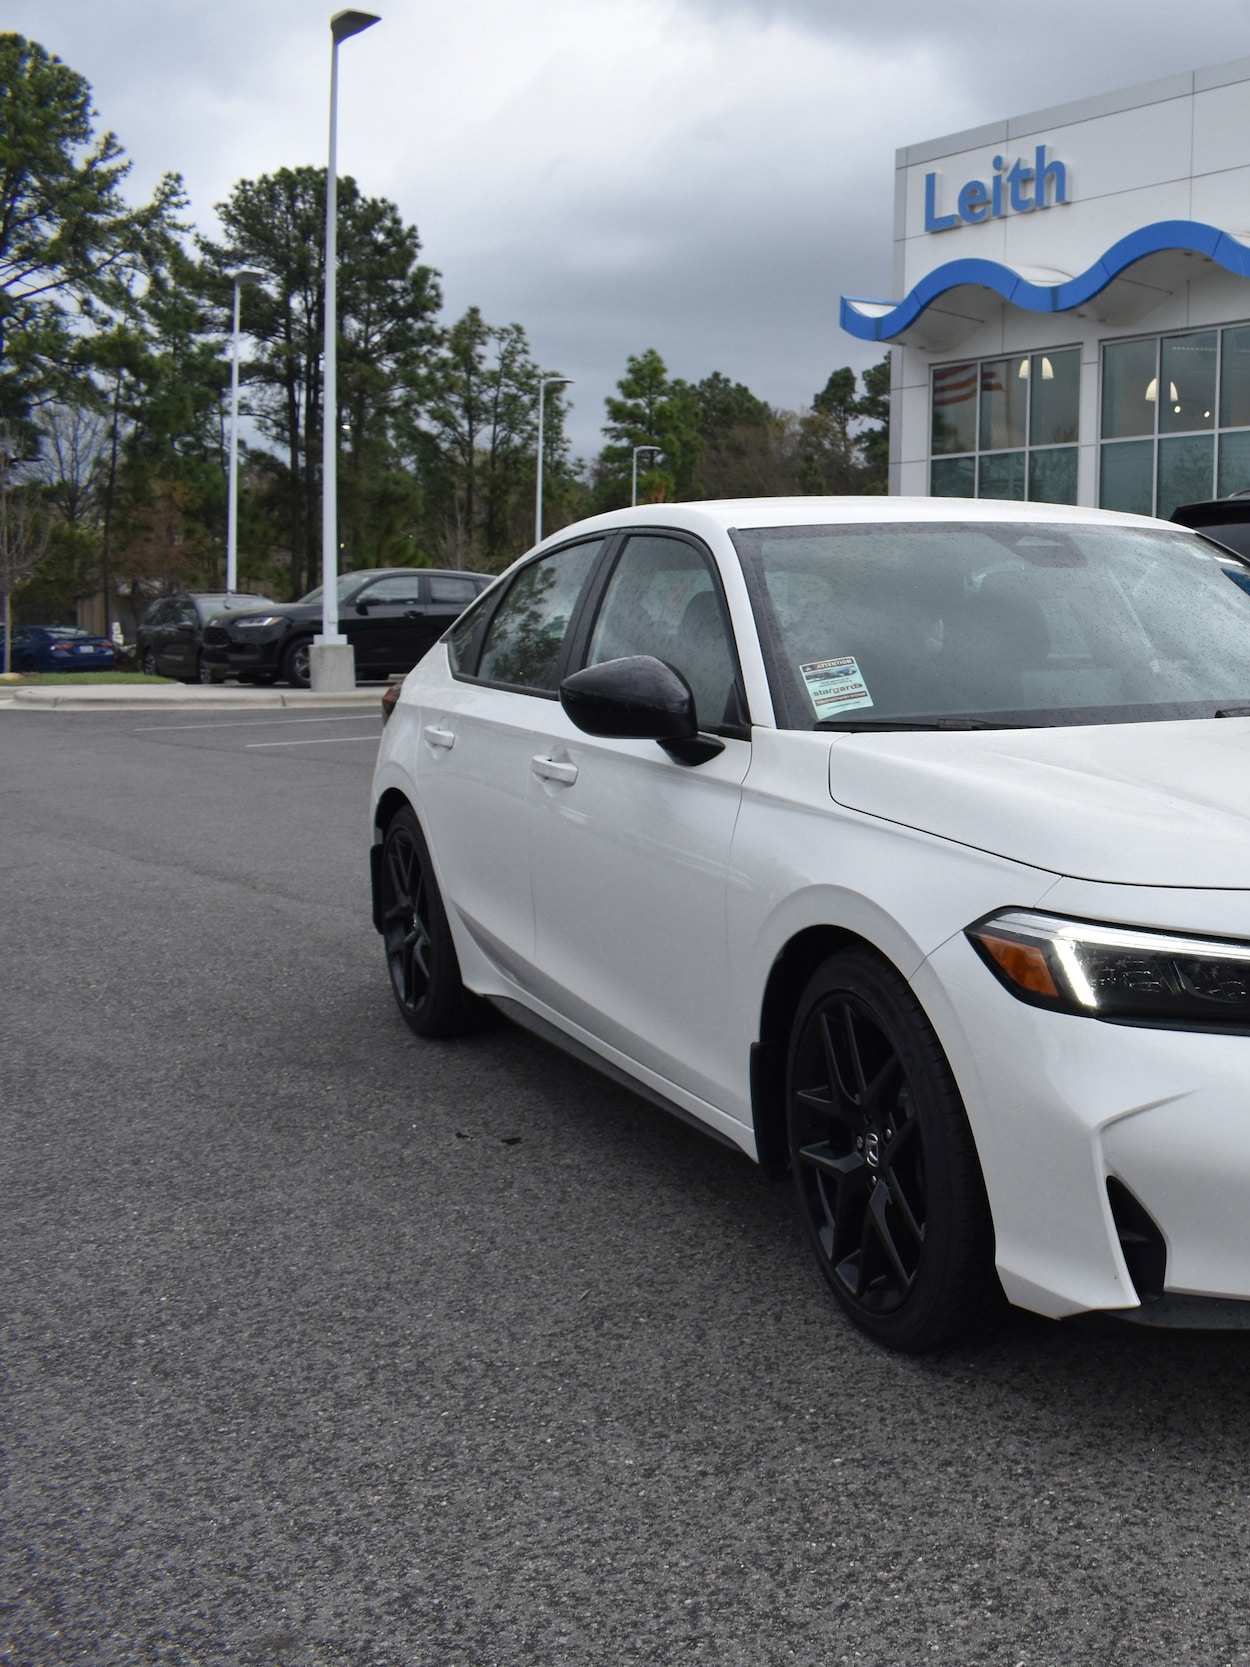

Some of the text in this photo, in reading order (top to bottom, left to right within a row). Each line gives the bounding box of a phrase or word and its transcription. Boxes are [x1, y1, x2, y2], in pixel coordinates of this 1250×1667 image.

[924, 144, 1067, 232] Leith
[816, 659, 852, 669] ATTENTION
[813, 683, 857, 696] stargard
